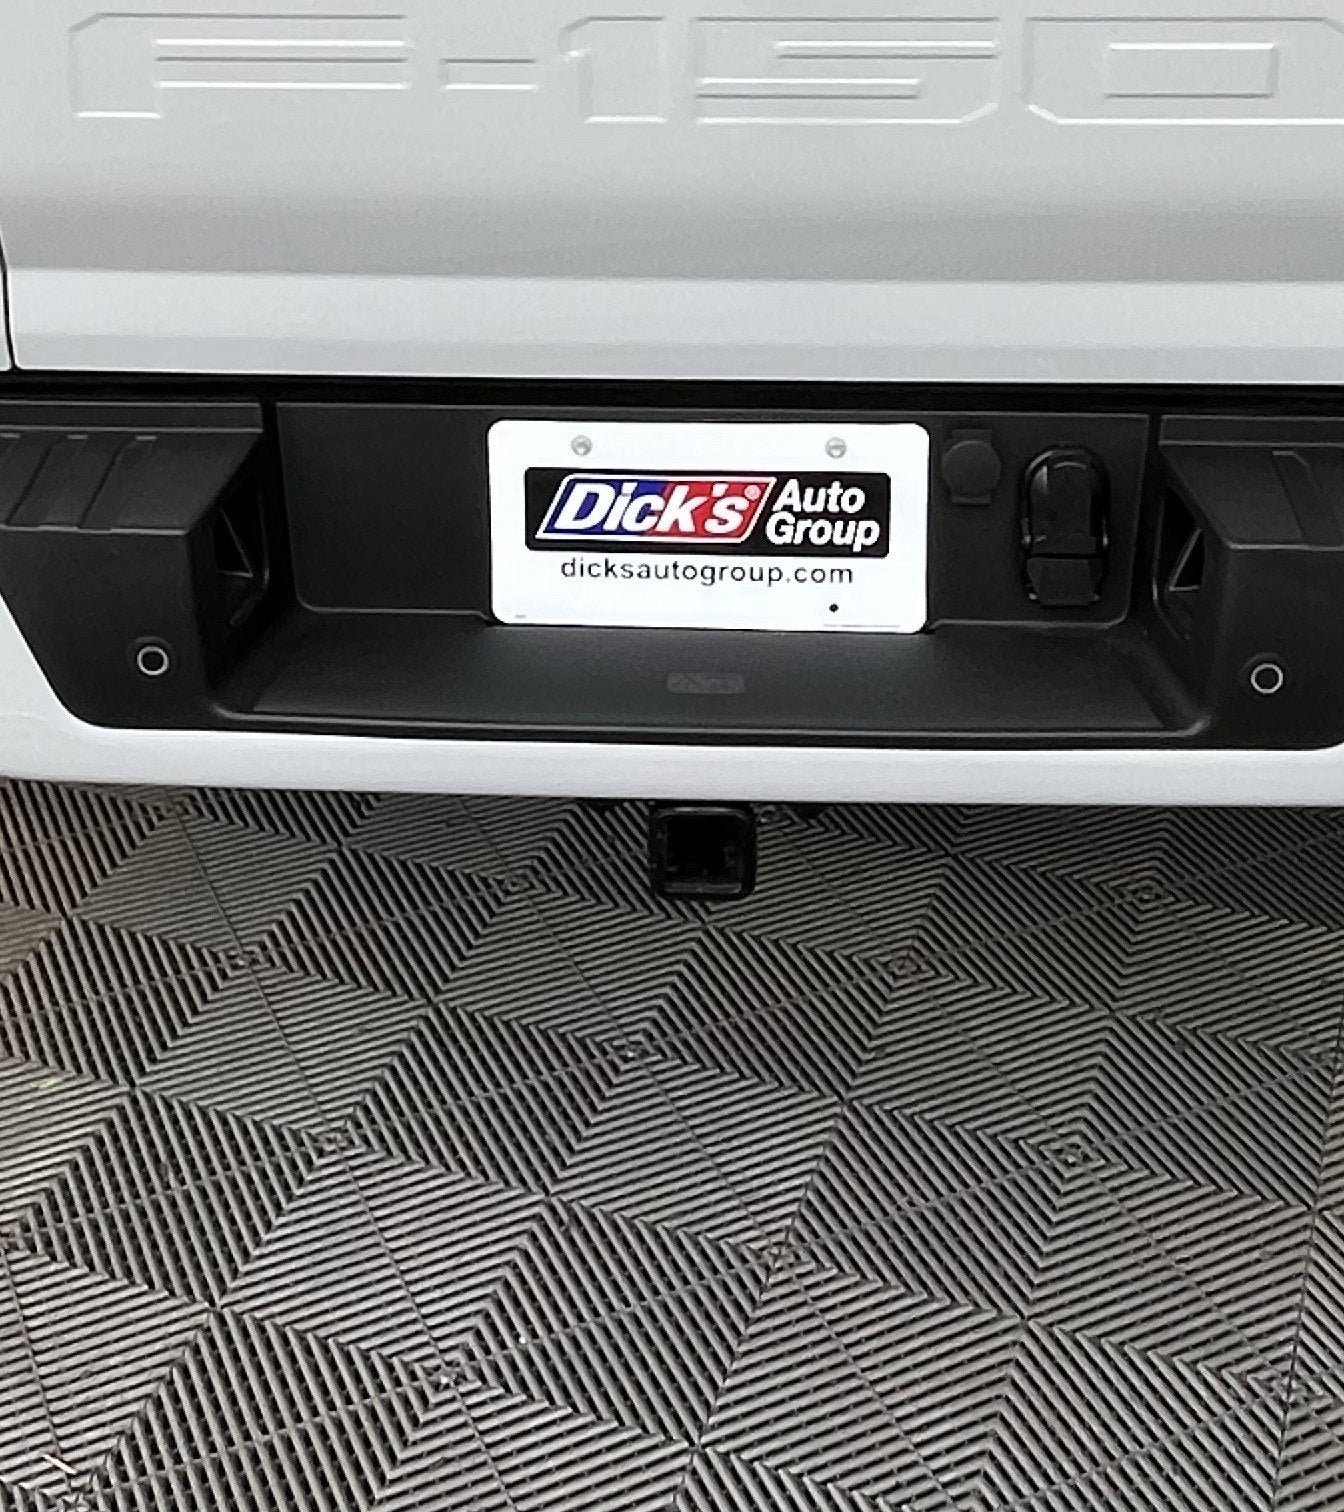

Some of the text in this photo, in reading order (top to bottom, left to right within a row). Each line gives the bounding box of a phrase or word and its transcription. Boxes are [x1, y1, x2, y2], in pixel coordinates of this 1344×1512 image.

[554, 482, 750, 534] Dick's
[772, 478, 866, 514] Auto
[766, 511, 880, 553] Group
[560, 557, 854, 587] dicksautogroup.com
